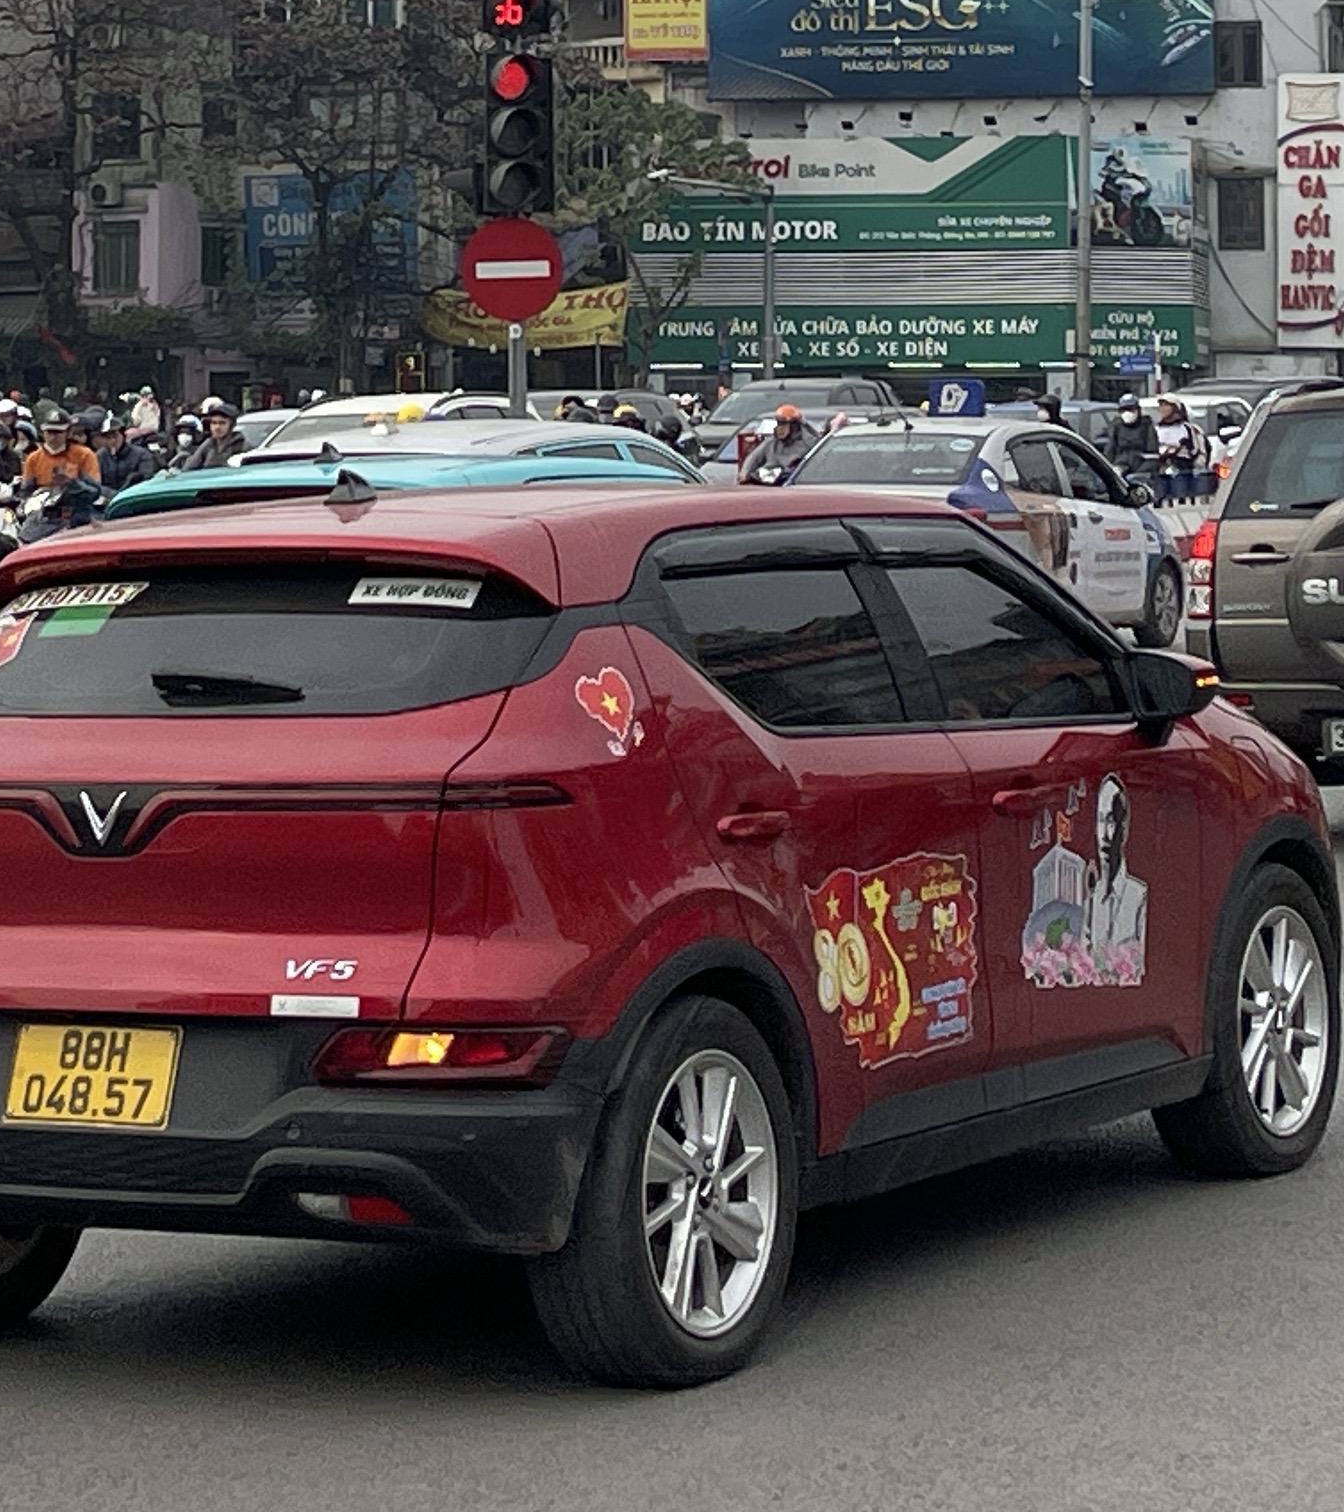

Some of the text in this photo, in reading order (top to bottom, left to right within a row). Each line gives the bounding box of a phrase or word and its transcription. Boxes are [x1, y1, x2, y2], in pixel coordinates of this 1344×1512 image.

[1283, 140, 1341, 170] CHĂN
[834, 163, 876, 179] Point
[1297, 174, 1328, 199] GA
[751, 220, 839, 243] MOTOR
[1294, 203, 1331, 239] GỐI
[1291, 243, 1335, 281] ĐỆM
[773, 315, 798, 336] ỬA
[801, 316, 849, 336] CHỮA
[856, 314, 892, 336] BẢO
[899, 315, 966, 336] DƯỠNG
[973, 319, 994, 335] XE
[1001, 314, 1040, 335] MÁY
[737, 341, 759, 357] XE
[808, 342, 830, 356] XE
[835, 337, 860, 357] SỐ
[876, 341, 899, 356] XE
[8, 581, 146, 613] 976079157
[361, 583, 384, 597] XE
[285, 957, 359, 982] VF5
[57, 1027, 129, 1074] 88H
[20, 1074, 155, 1121] 048.57
